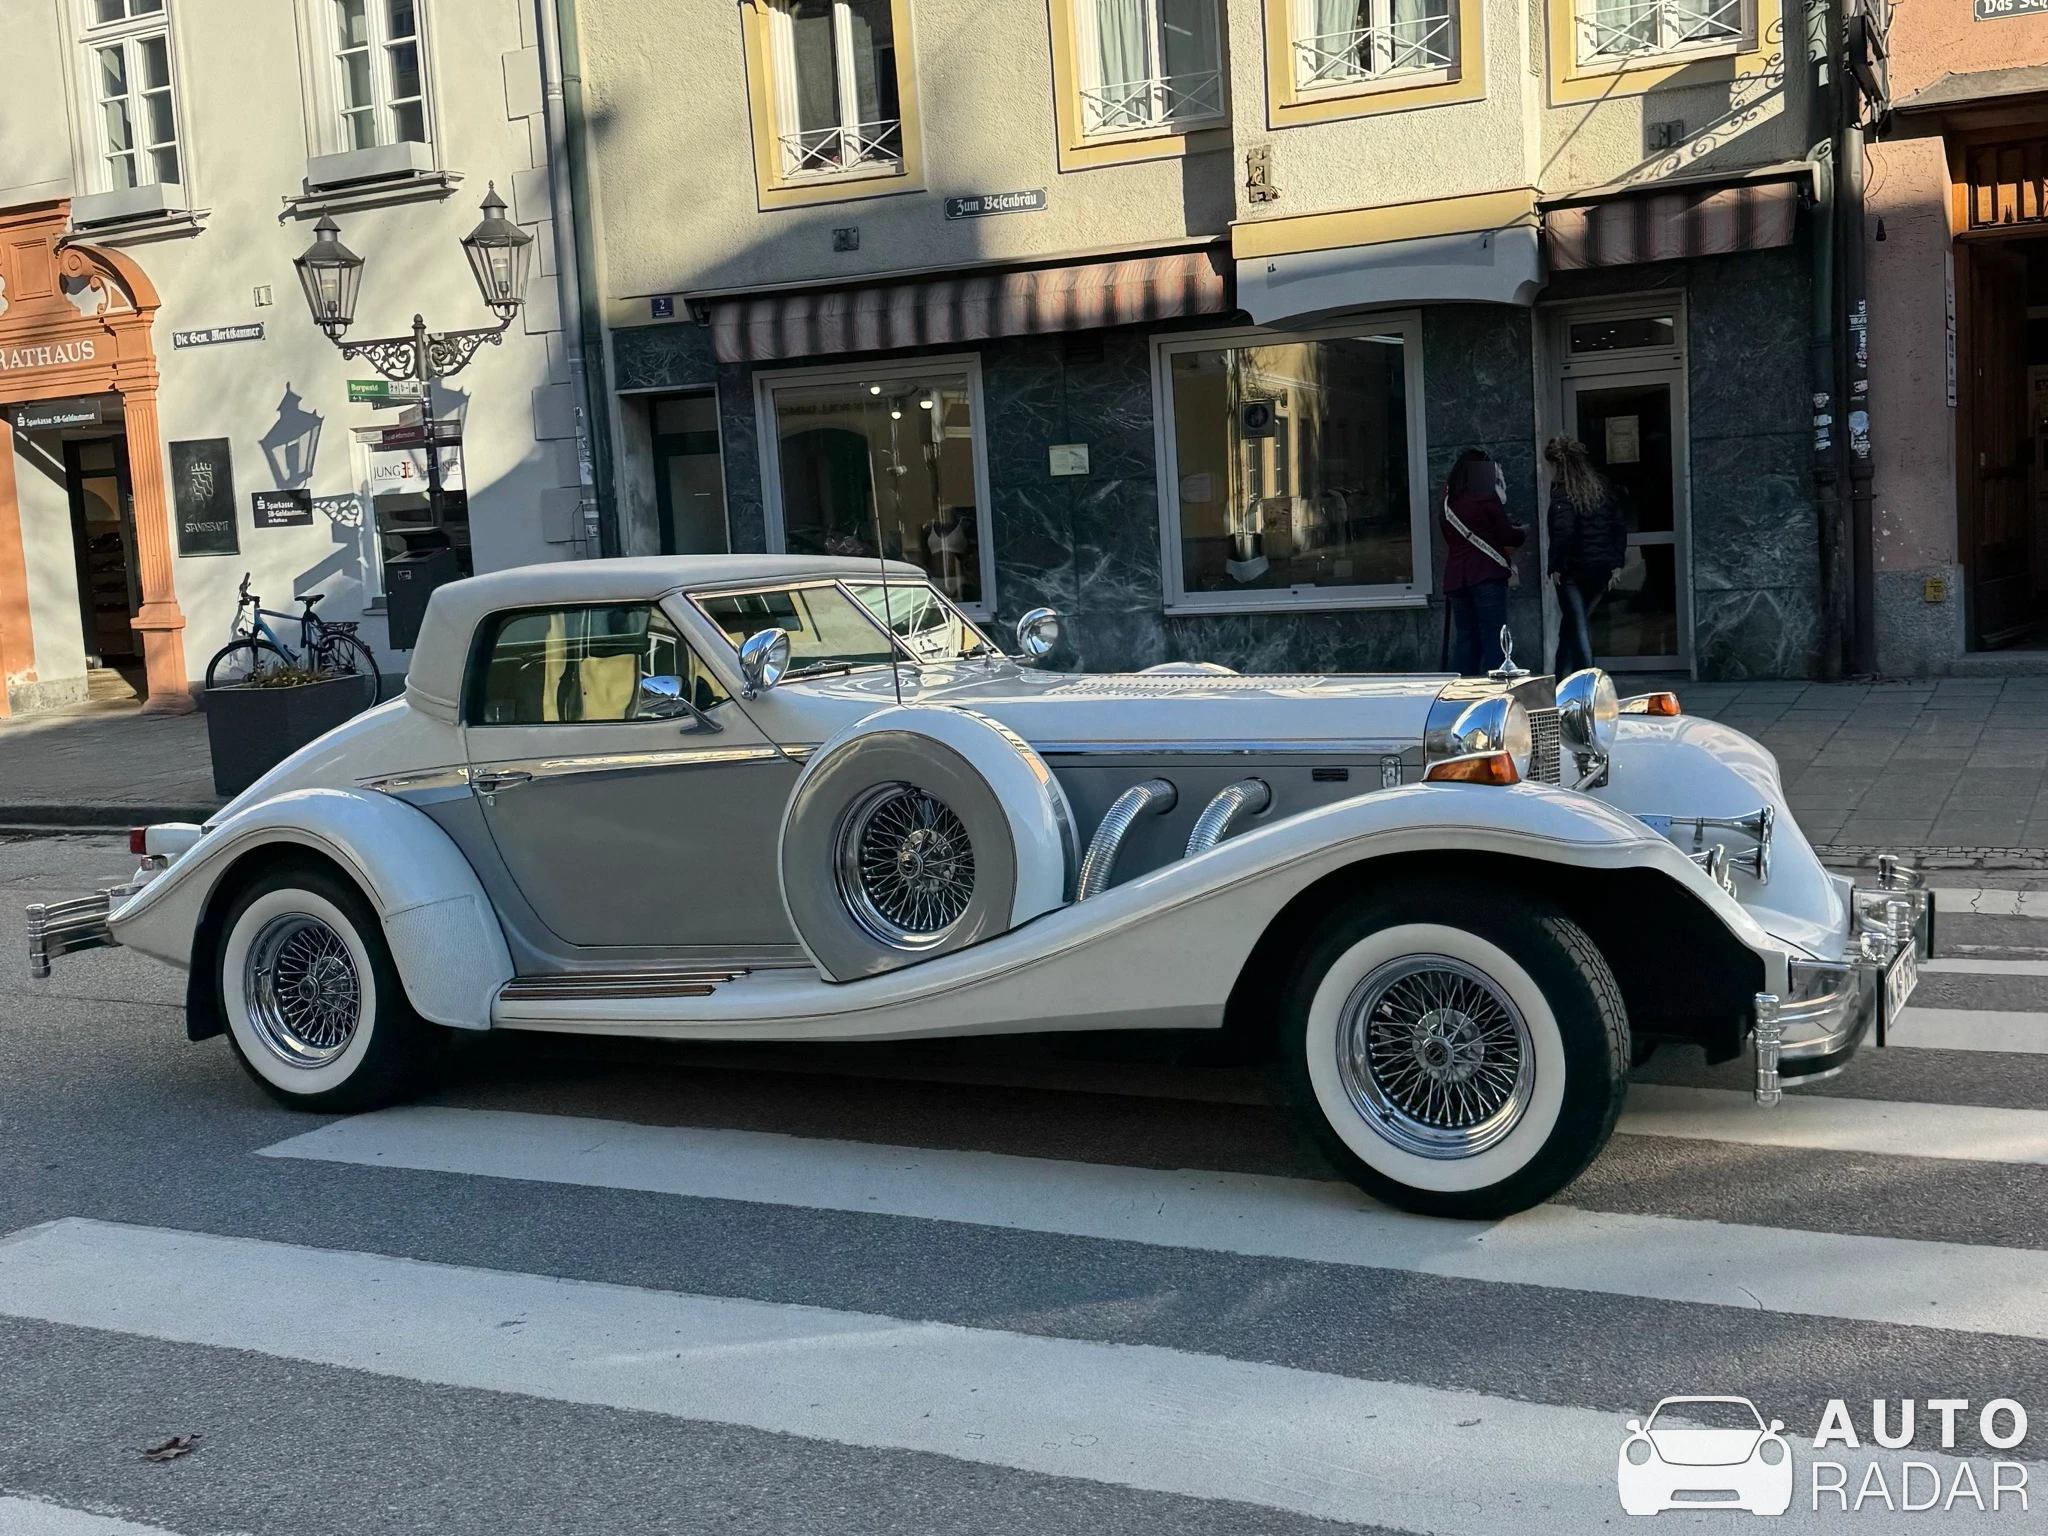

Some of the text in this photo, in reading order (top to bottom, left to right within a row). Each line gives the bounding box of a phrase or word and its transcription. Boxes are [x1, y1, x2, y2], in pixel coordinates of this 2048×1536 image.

[956, 199, 979, 215] Zum
[659, 299, 665, 310] 2
[26, 417, 52, 427] Sparkasse
[266, 501, 294, 511] Sparkasse
